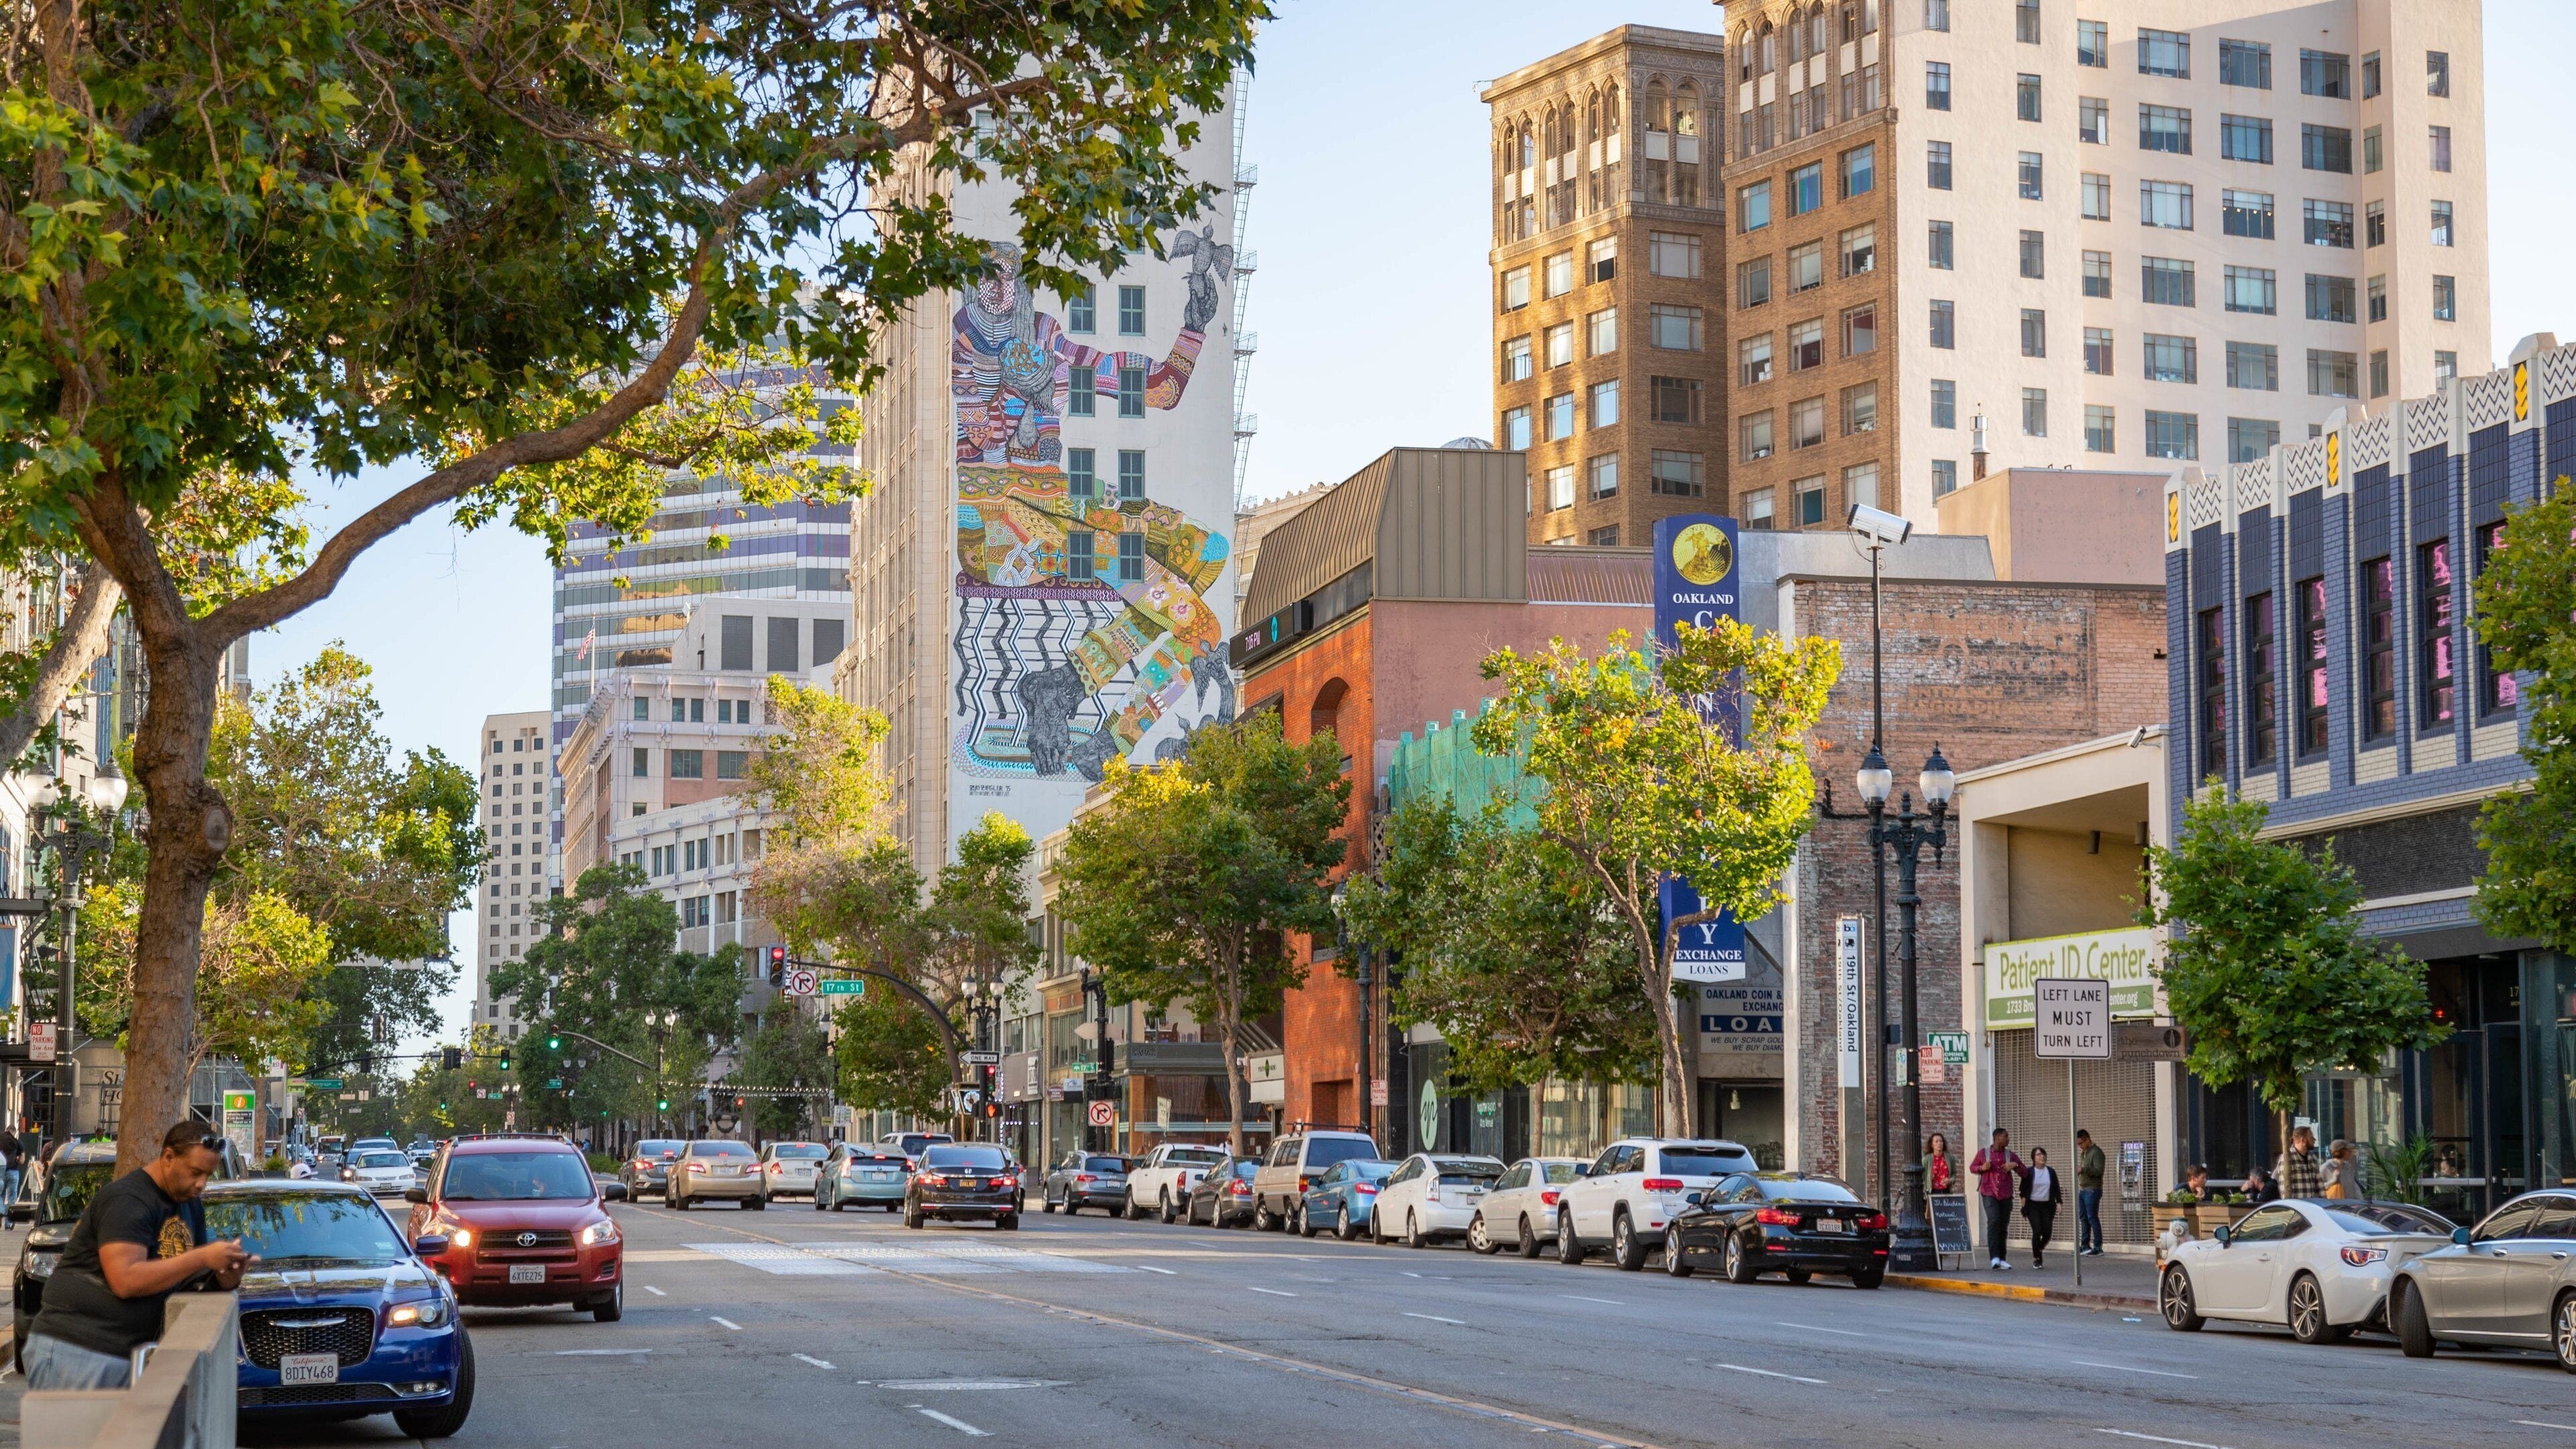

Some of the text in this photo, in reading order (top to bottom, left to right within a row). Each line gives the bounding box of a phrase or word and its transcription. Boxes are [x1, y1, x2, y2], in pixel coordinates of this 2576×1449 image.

[1673, 593, 1734, 605] OAKLAND
[1676, 950, 1742, 960] EXCHANGE
[1689, 965, 1729, 974] LOANS
[1847, 955, 1856, 980] 19th
[2000, 941, 2146, 990] Patient ID Center
[826, 983, 859, 991] 17th St
[1706, 989, 1782, 1000] OAKLAND COIN &
[2043, 989, 2102, 1002] LEFT LANE
[1743, 1002, 1784, 1012] EXCHANG
[2006, 991, 2138, 1014] 1733 Bro enter.org
[2053, 1011, 2092, 1026] MUST
[33, 1026, 41, 1034] NO
[1709, 1017, 1783, 1032] LOA
[1931, 1035, 1968, 1052] ATM
[2043, 1035, 2103, 1048] TURN LEFT
[2121, 1036, 2137, 1045] the
[1922, 1049, 1931, 1057] NO
[2121, 1049, 2180, 1059] punchdown
[512, 1271, 543, 1281] 6XTE275
[285, 1365, 334, 1381] 8DIY468
